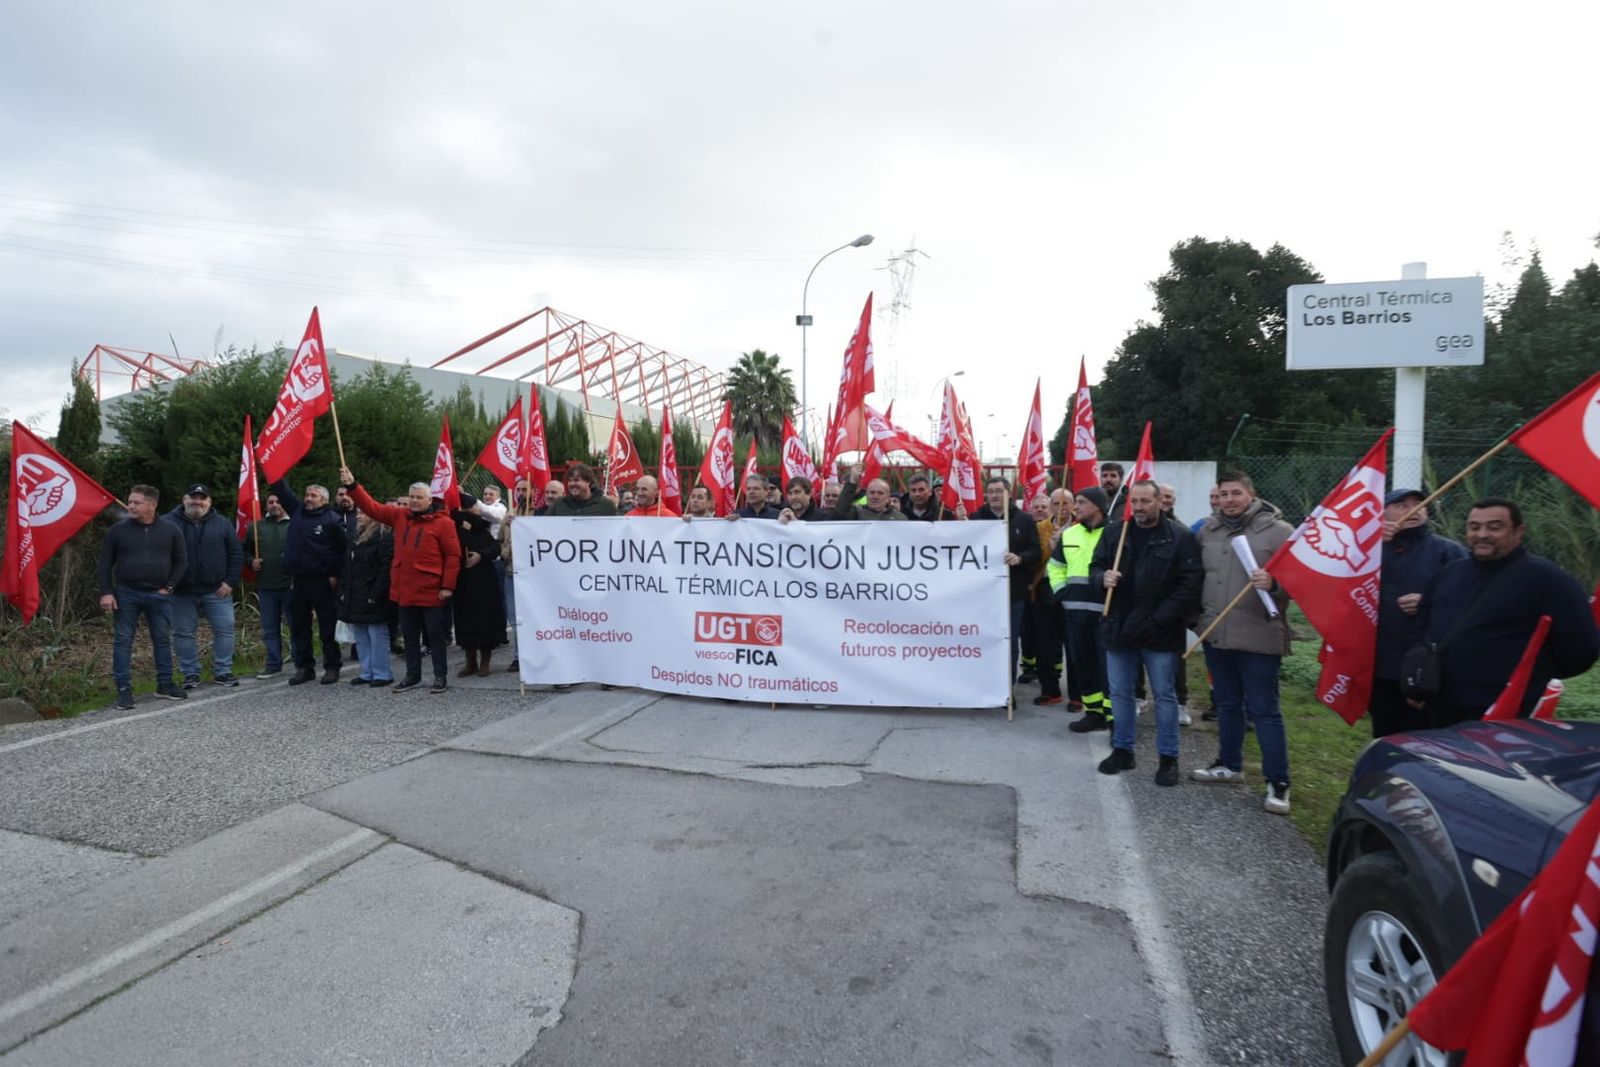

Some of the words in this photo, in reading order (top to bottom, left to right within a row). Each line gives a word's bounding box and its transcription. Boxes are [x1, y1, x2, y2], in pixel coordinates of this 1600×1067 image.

[1303, 292, 1371, 309] Central
[1377, 290, 1453, 306] Térmica
[1303, 312, 1335, 326] Los
[1342, 309, 1412, 325] Barrios
[529, 539, 599, 567] ¡POR
[608, 539, 667, 564] UNA
[673, 538, 866, 570] TRANSICIÓN
[877, 545, 989, 571] JUSTA!
[579, 574, 668, 593] CENTRAL
[675, 573, 769, 597] TÉRMICA
[774, 580, 818, 599] LOS
[825, 582, 929, 601] BARRIOS
[557, 606, 608, 625] Diálogo
[535, 626, 576, 641] social
[579, 629, 633, 643] efectivo
[698, 615, 752, 641] UGT
[844, 619, 953, 636] Recolocación
[959, 623, 979, 636] en
[735, 648, 778, 667] FICA
[841, 642, 897, 657] futuros
[902, 643, 982, 661] proyectos
[651, 665, 713, 687] Despidos
[717, 672, 743, 688] NO
[748, 674, 839, 692] traumáticos
